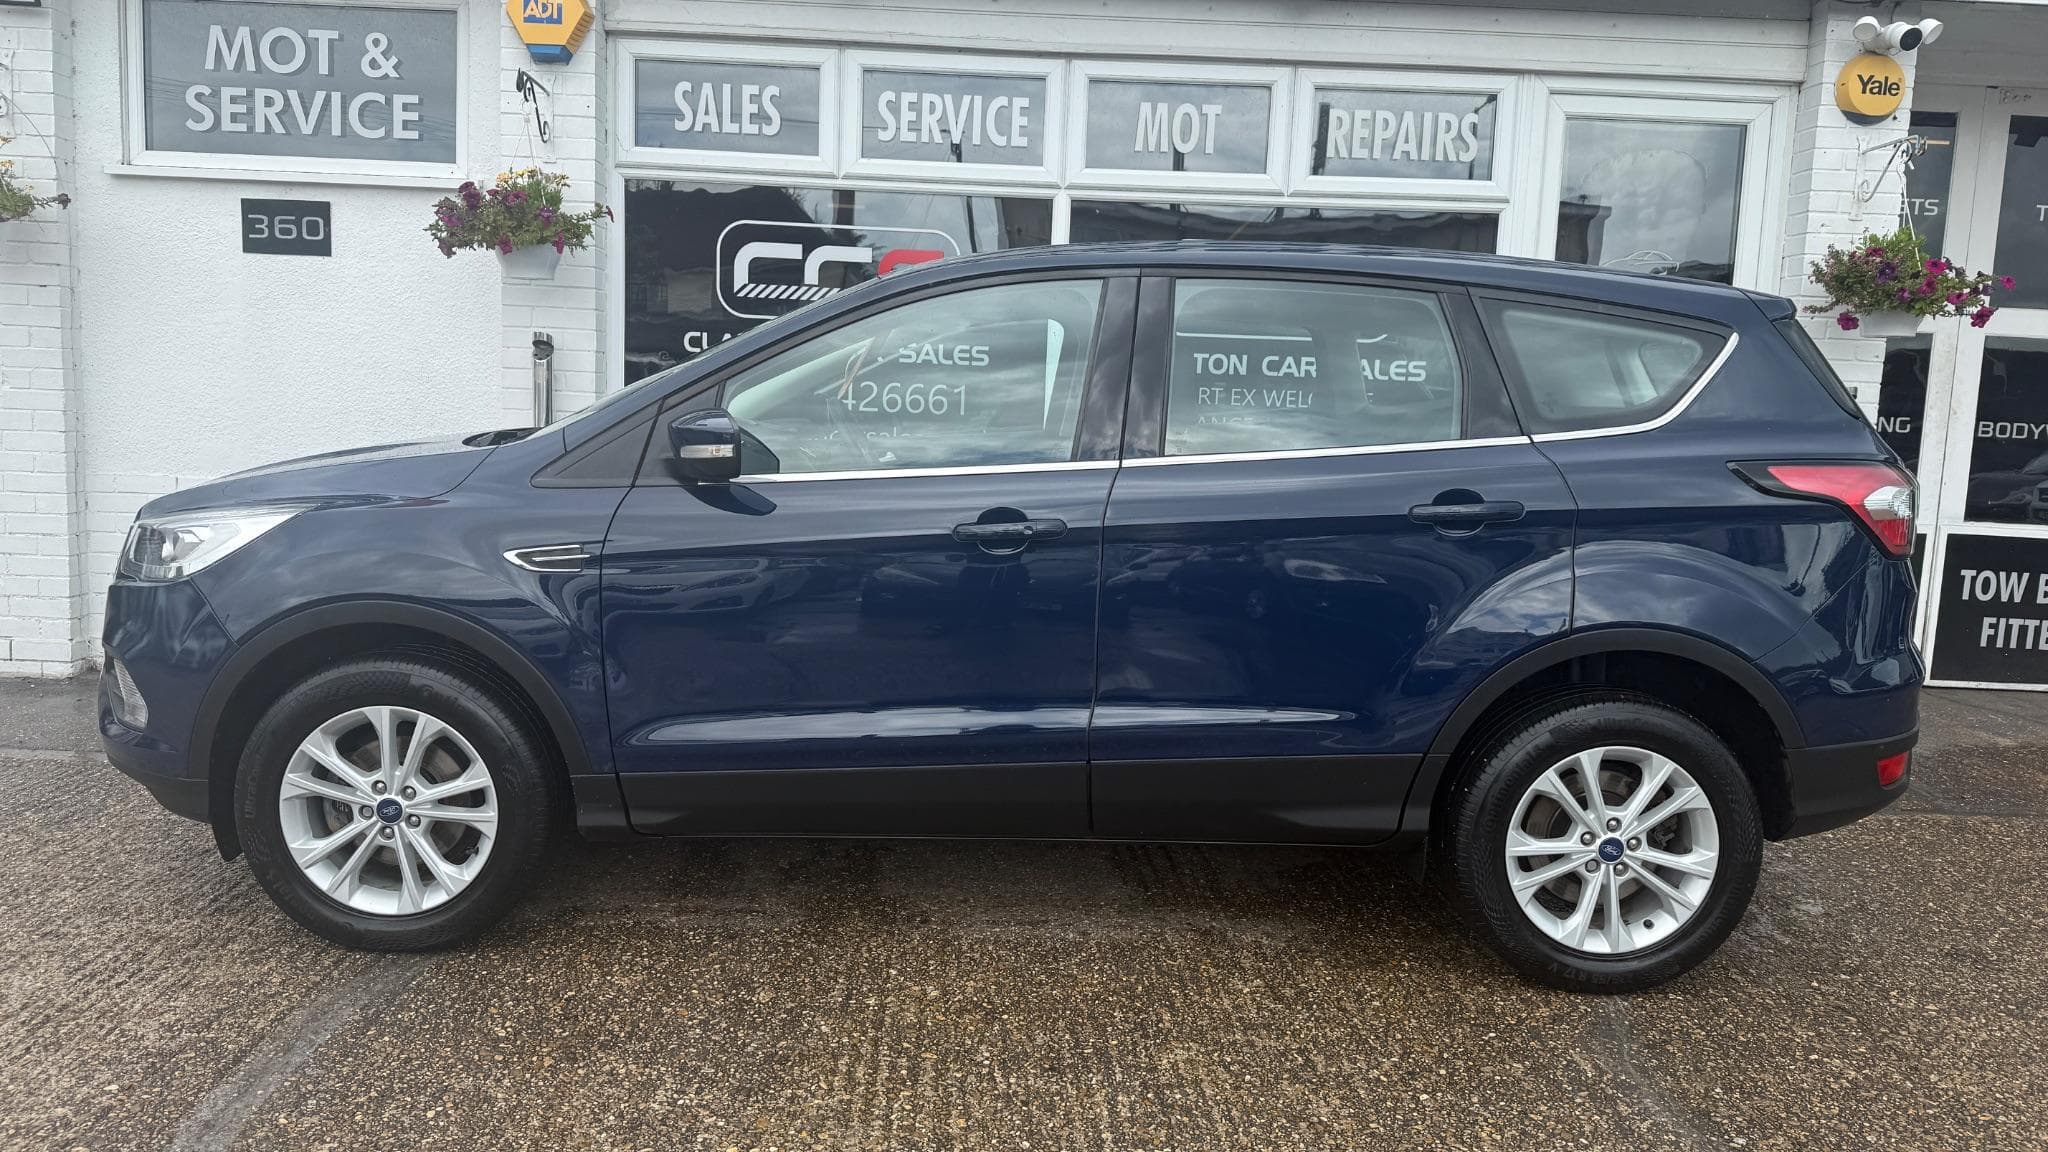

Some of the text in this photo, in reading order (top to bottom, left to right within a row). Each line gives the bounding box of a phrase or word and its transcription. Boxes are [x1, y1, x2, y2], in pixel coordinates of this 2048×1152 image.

[523, 0, 562, 19] ADT
[205, 25, 400, 78] MOT &
[1857, 74, 1900, 97] Yale
[185, 85, 420, 140] SERVICE
[674, 81, 782, 136] SALES
[877, 90, 1030, 147] SERVICE
[1134, 102, 1222, 154] MOT
[1326, 108, 1479, 162] REPAIRS
[248, 214, 325, 240] 360
[899, 343, 990, 366] SALES
[1261, 355, 1317, 378] CAR
[1360, 358, 1427, 381] ALES
[1231, 388, 1257, 407] EX
[1263, 389, 1313, 408] WEL
[1978, 421, 2048, 440] BODY
[1960, 569, 2030, 603] TOW
